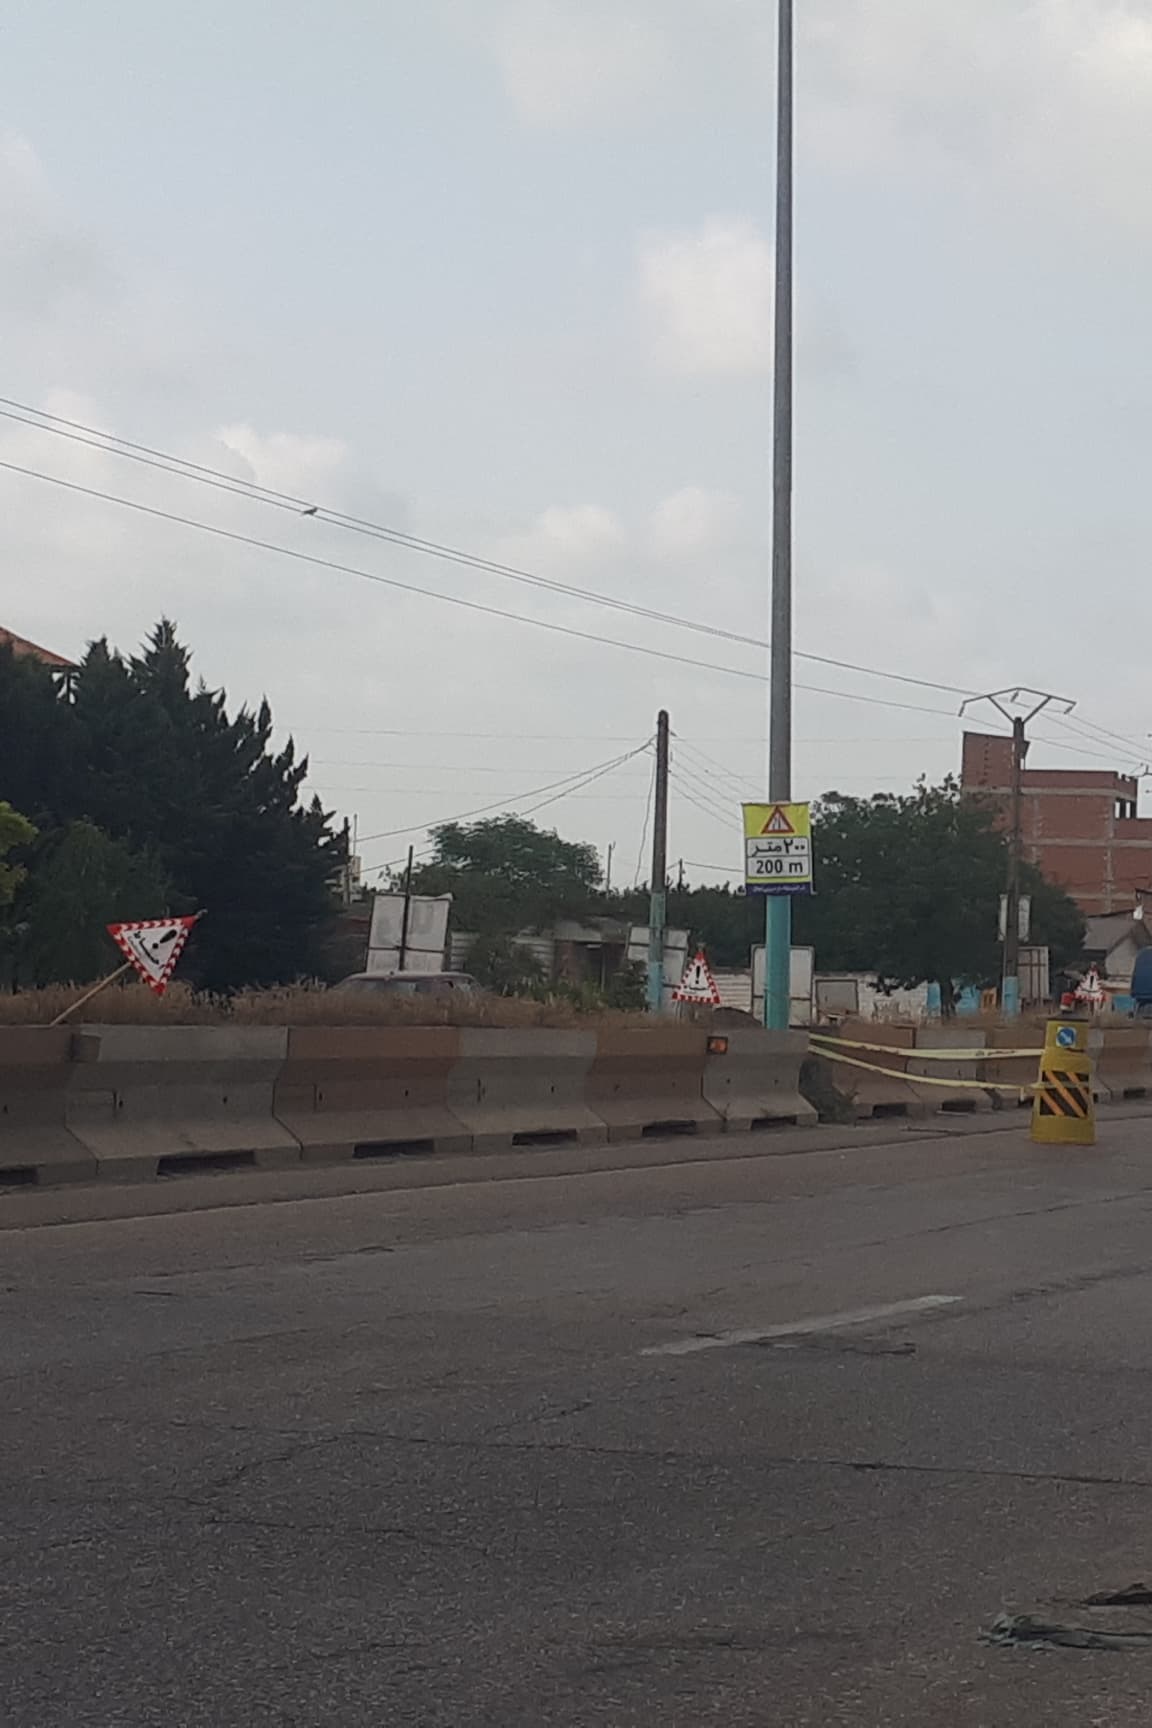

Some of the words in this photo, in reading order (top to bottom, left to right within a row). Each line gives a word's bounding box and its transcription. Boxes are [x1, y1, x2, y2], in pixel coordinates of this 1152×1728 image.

[752, 841, 782, 857] متر
[756, 859, 783, 874] 200
[788, 862, 803, 873] m
